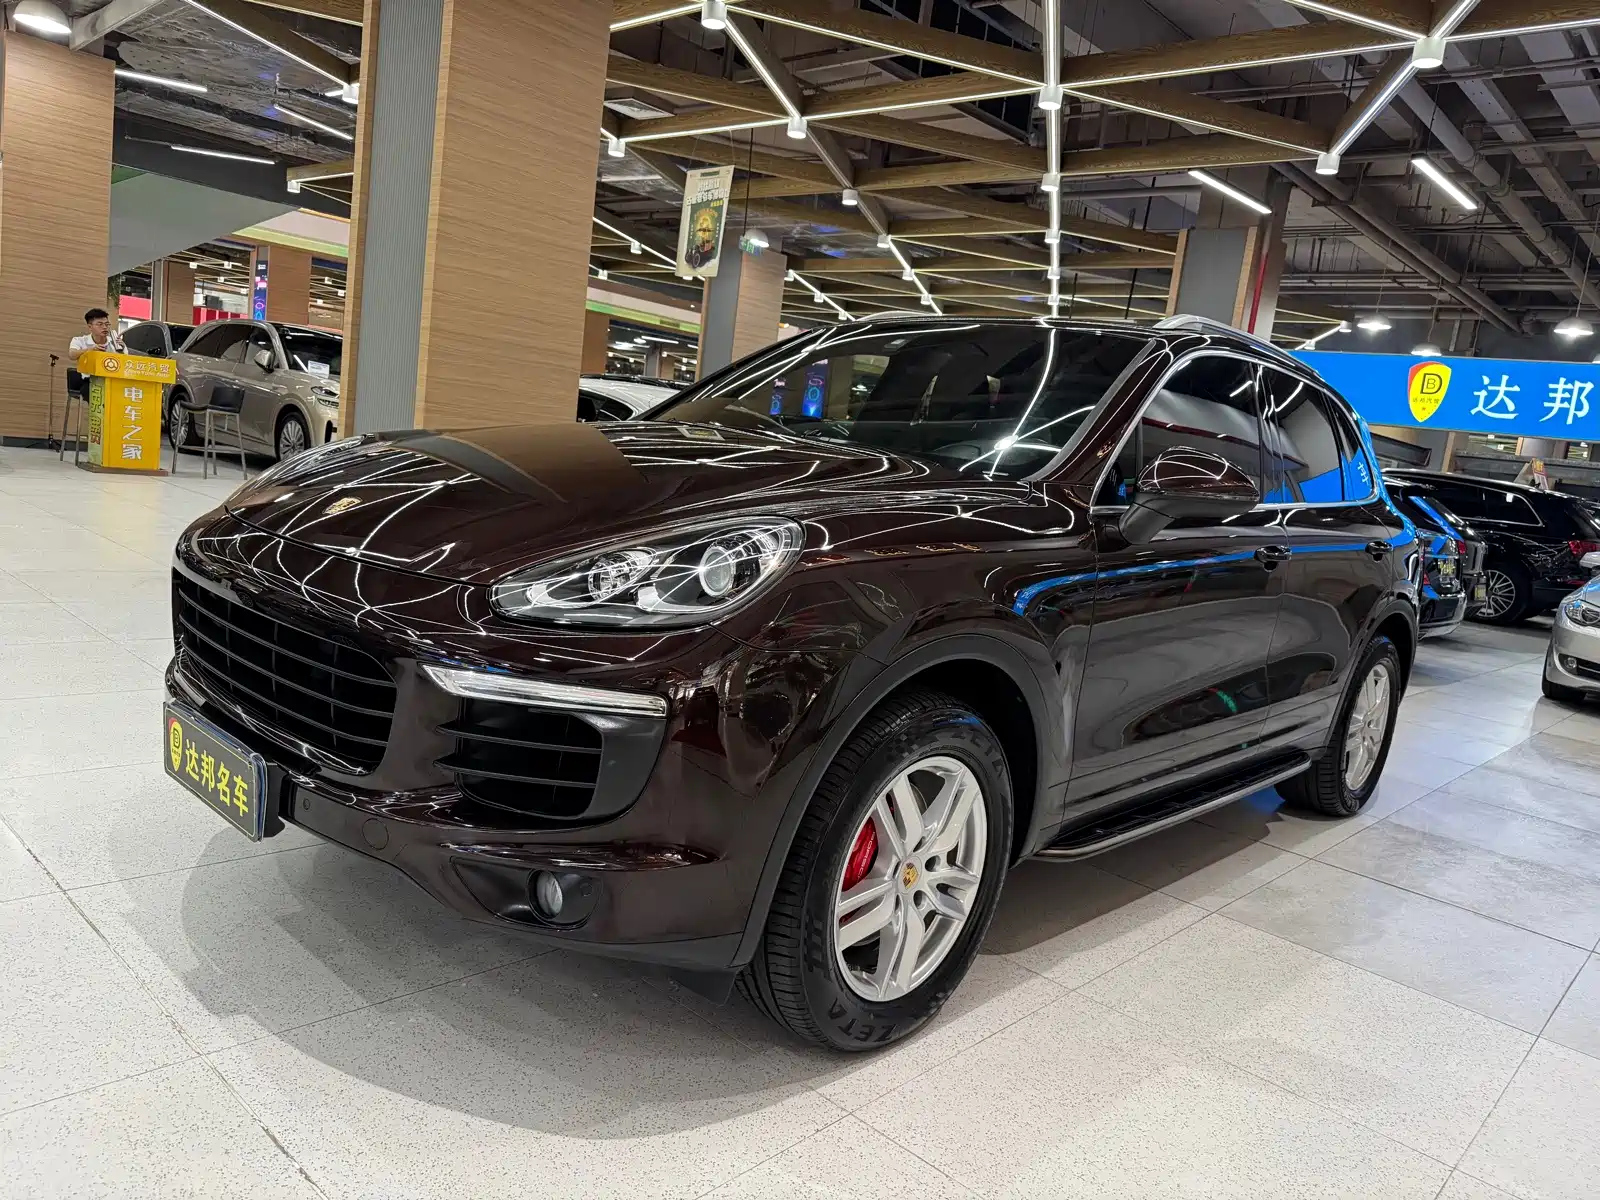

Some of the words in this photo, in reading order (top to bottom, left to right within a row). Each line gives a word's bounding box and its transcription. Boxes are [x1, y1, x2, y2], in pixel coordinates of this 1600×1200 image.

[122, 386, 142, 460] 电车之家
[1470, 374, 1595, 425] 达邦
[185, 739, 249, 817] 达邦名车
[828, 997, 898, 1043] ZETA
